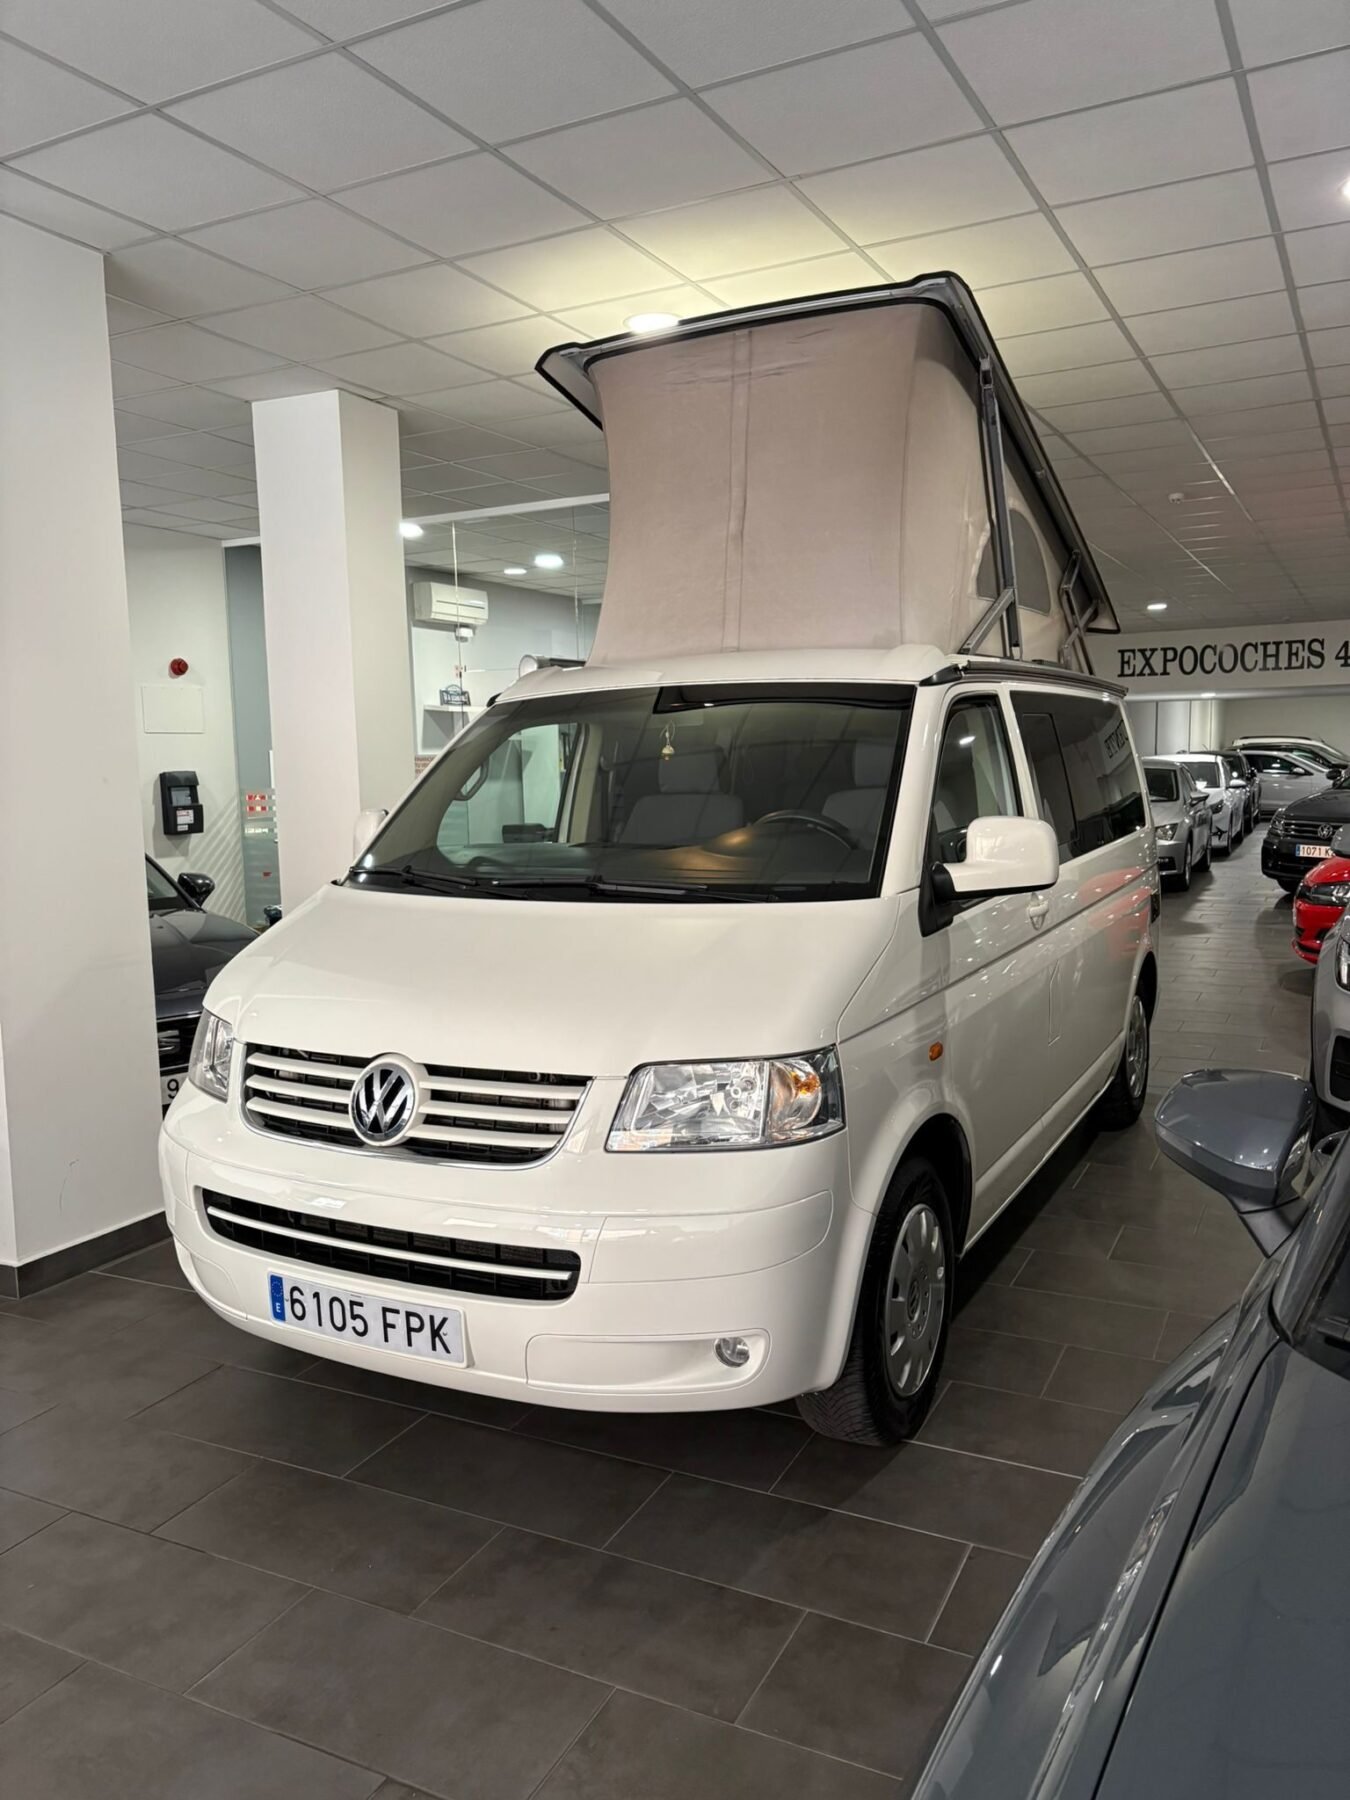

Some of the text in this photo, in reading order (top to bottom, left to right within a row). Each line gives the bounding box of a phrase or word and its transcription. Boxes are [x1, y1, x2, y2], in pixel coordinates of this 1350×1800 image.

[1117, 638, 1326, 677] EXPOCOCHES
[1302, 846, 1322, 856] 1071
[275, 1302, 281, 1313] E
[289, 1285, 451, 1354] 6105 FPK
